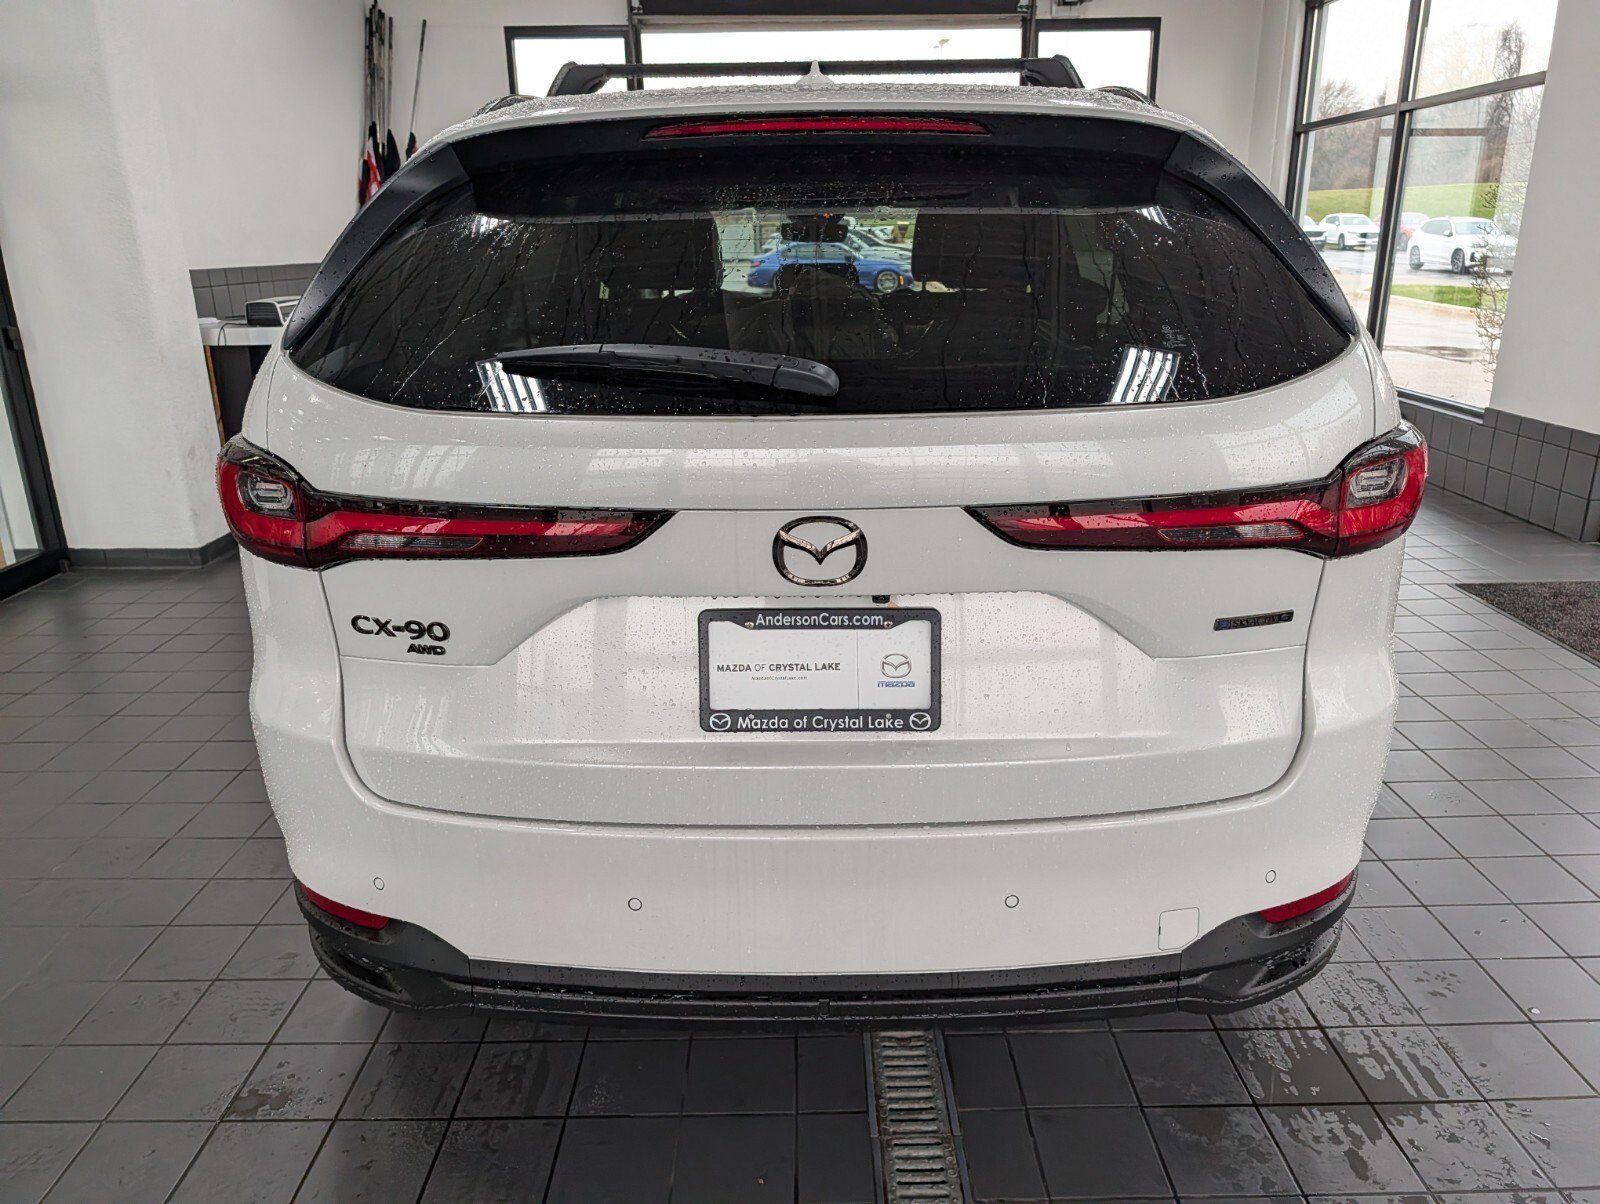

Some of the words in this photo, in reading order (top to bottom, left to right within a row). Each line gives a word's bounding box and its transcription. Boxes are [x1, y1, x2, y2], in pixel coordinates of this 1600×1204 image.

[755, 612, 884, 627] AndersonCars.com
[350, 614, 451, 642] CX-90
[406, 643, 447, 656] AWD
[716, 663, 752, 673] MAZDA
[754, 663, 767, 672] OF
[768, 662, 813, 672] CRYSTAL
[814, 662, 841, 671] LAKE
[737, 715, 789, 729] Mazda
[793, 715, 808, 729] of
[812, 715, 863, 731] Crystal
[868, 715, 904, 729] Lake
